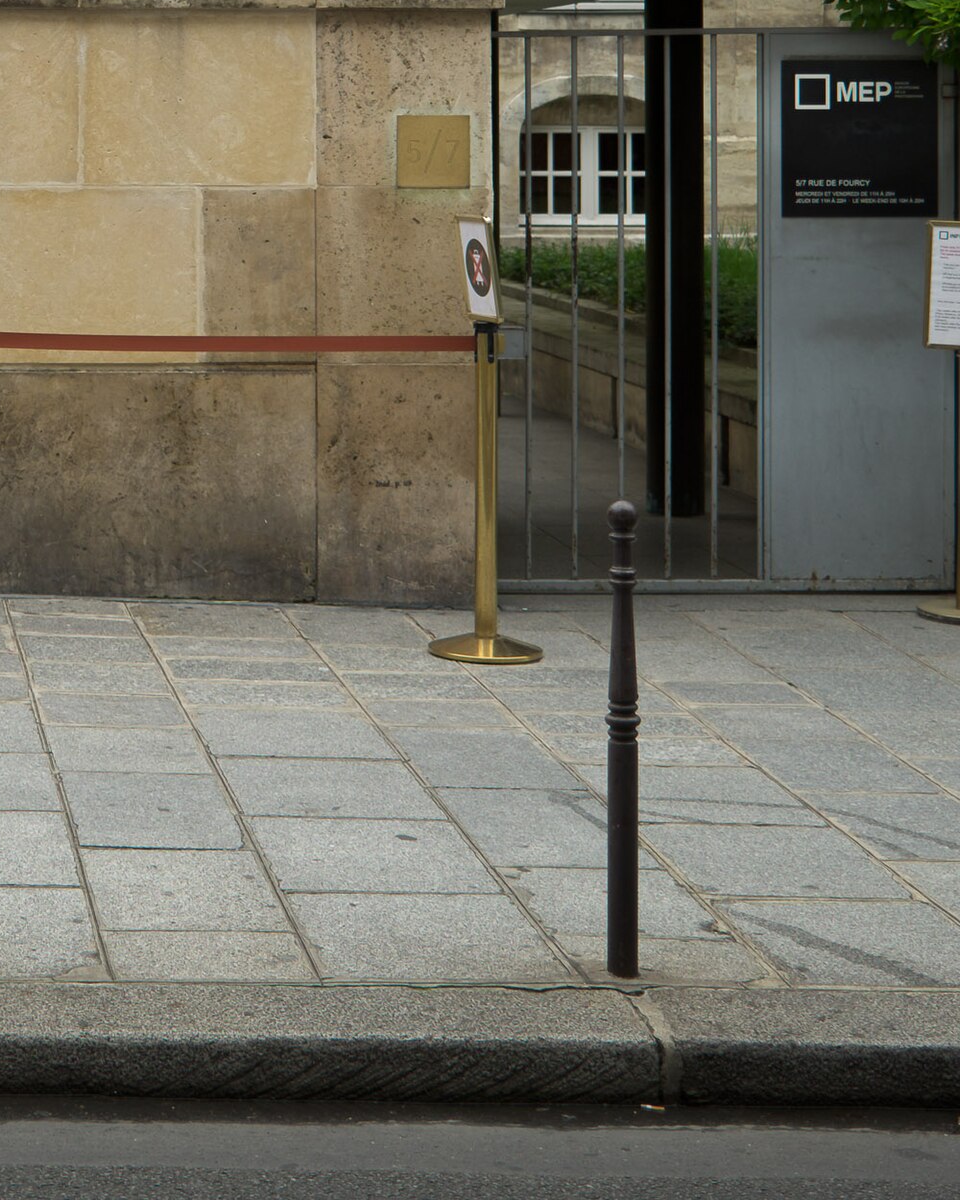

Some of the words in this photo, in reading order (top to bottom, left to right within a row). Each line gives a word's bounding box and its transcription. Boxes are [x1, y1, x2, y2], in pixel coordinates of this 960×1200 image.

[836, 81, 892, 103] MEP
[808, 179, 824, 187] RUE
[826, 179, 837, 187] DE
[838, 179, 871, 187] FOURCY
